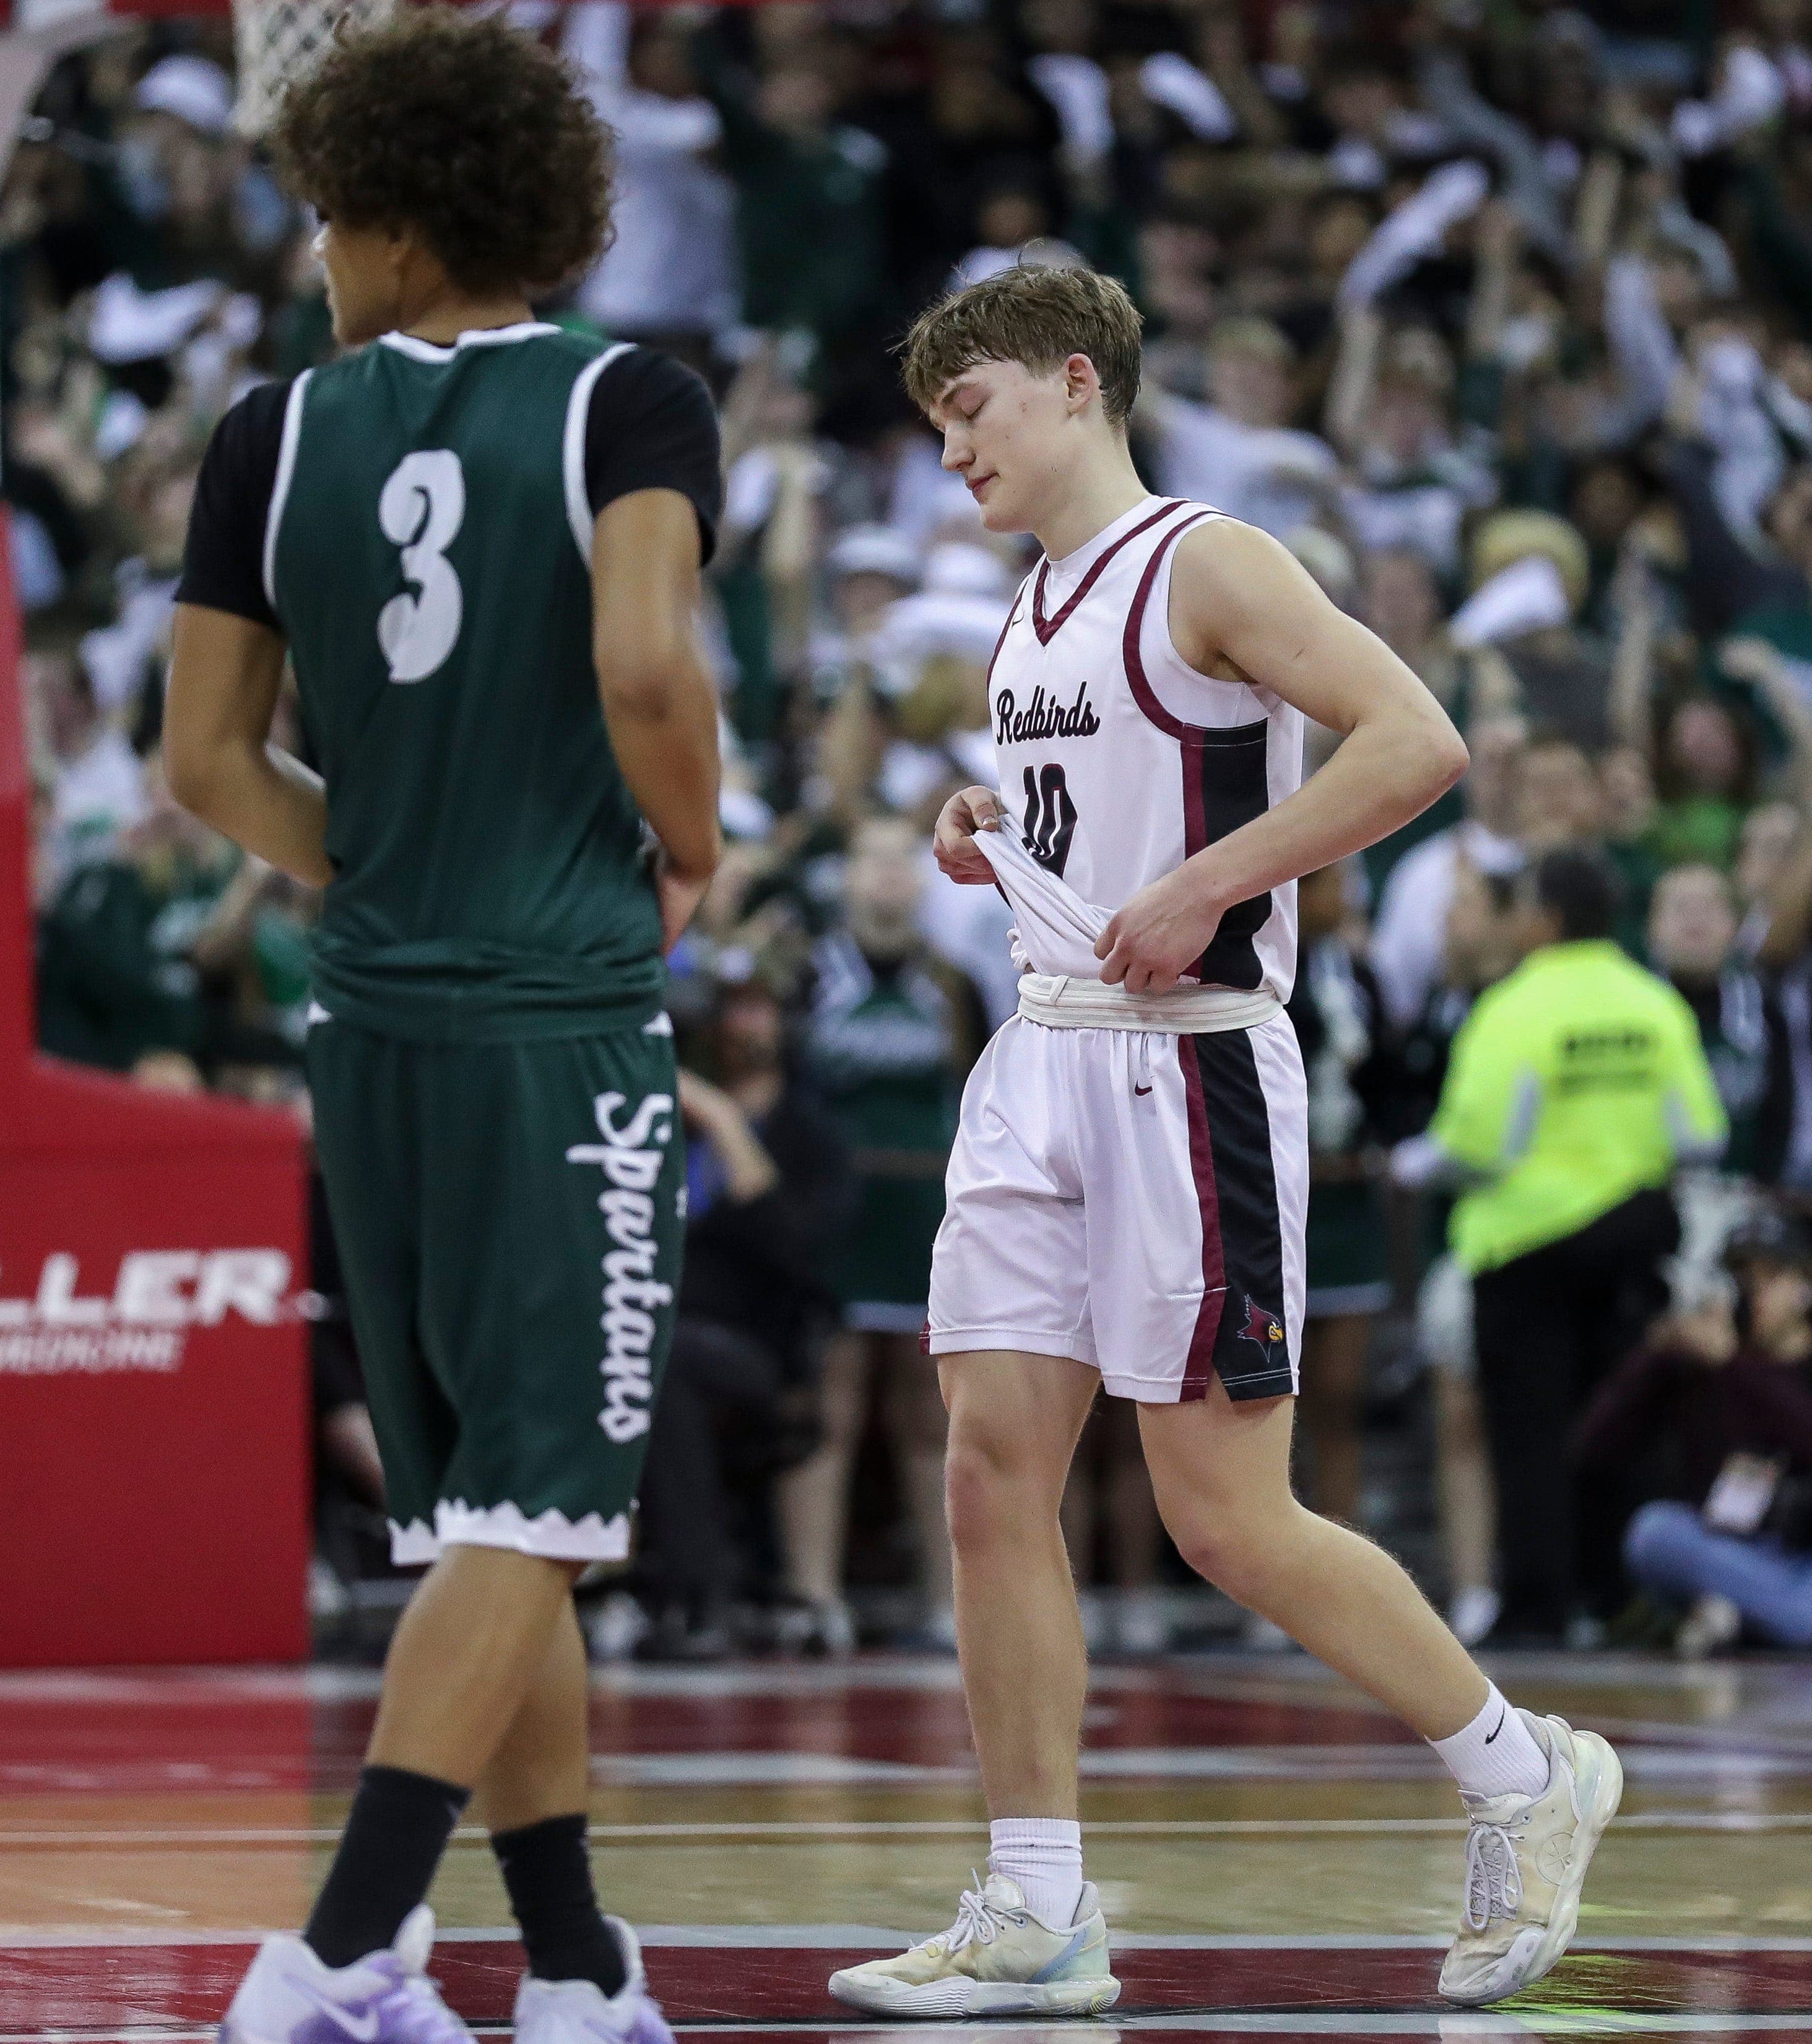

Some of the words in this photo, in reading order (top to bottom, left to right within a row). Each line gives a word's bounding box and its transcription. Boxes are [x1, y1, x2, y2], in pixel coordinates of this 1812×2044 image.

[377, 448, 466, 684] 3
[996, 681, 1101, 745] Redbirds
[1022, 762, 1078, 881] 10
[565, 1091, 674, 1443] Spartans
